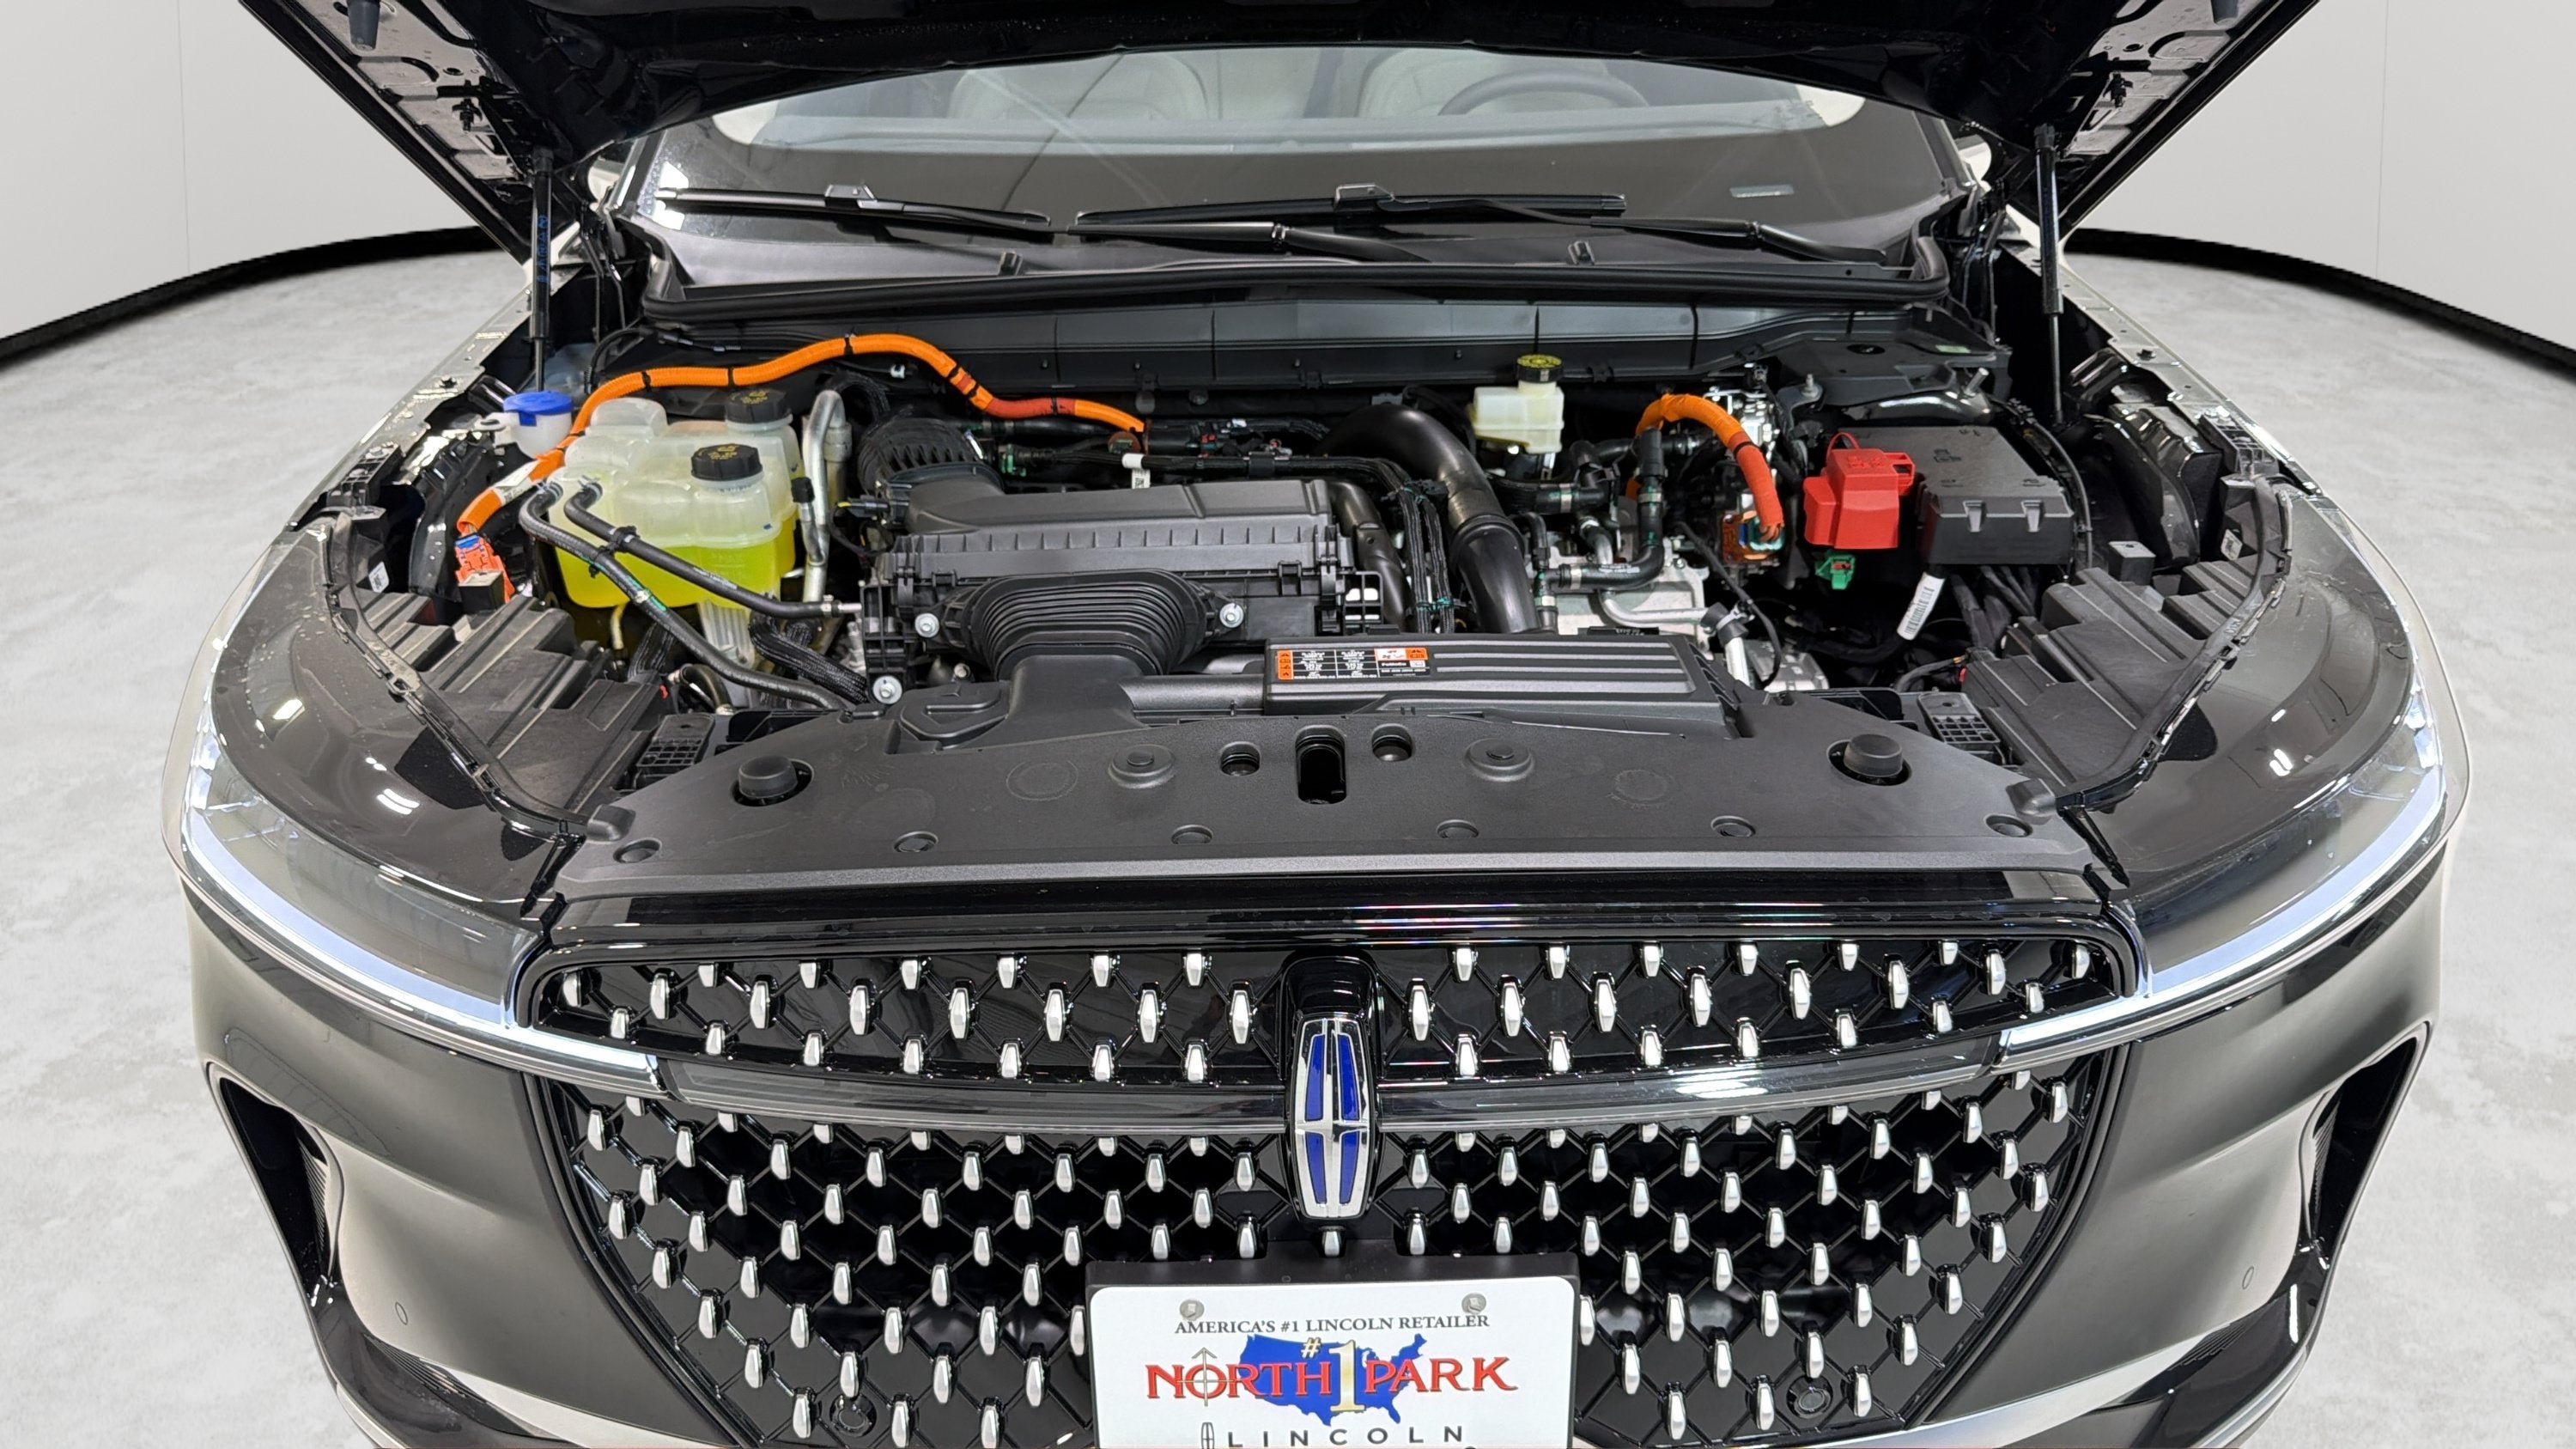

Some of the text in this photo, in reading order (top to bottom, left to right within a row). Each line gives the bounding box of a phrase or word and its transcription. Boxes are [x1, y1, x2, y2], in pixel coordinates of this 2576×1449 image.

[1174, 1314, 1490, 1334] AMERICA'S #1 LINCOLN RETAILER
[1145, 1361, 1333, 1399] NORTH
[1364, 1356, 1519, 1394] PARK
[1227, 1425, 1462, 1449] LINCOLN
